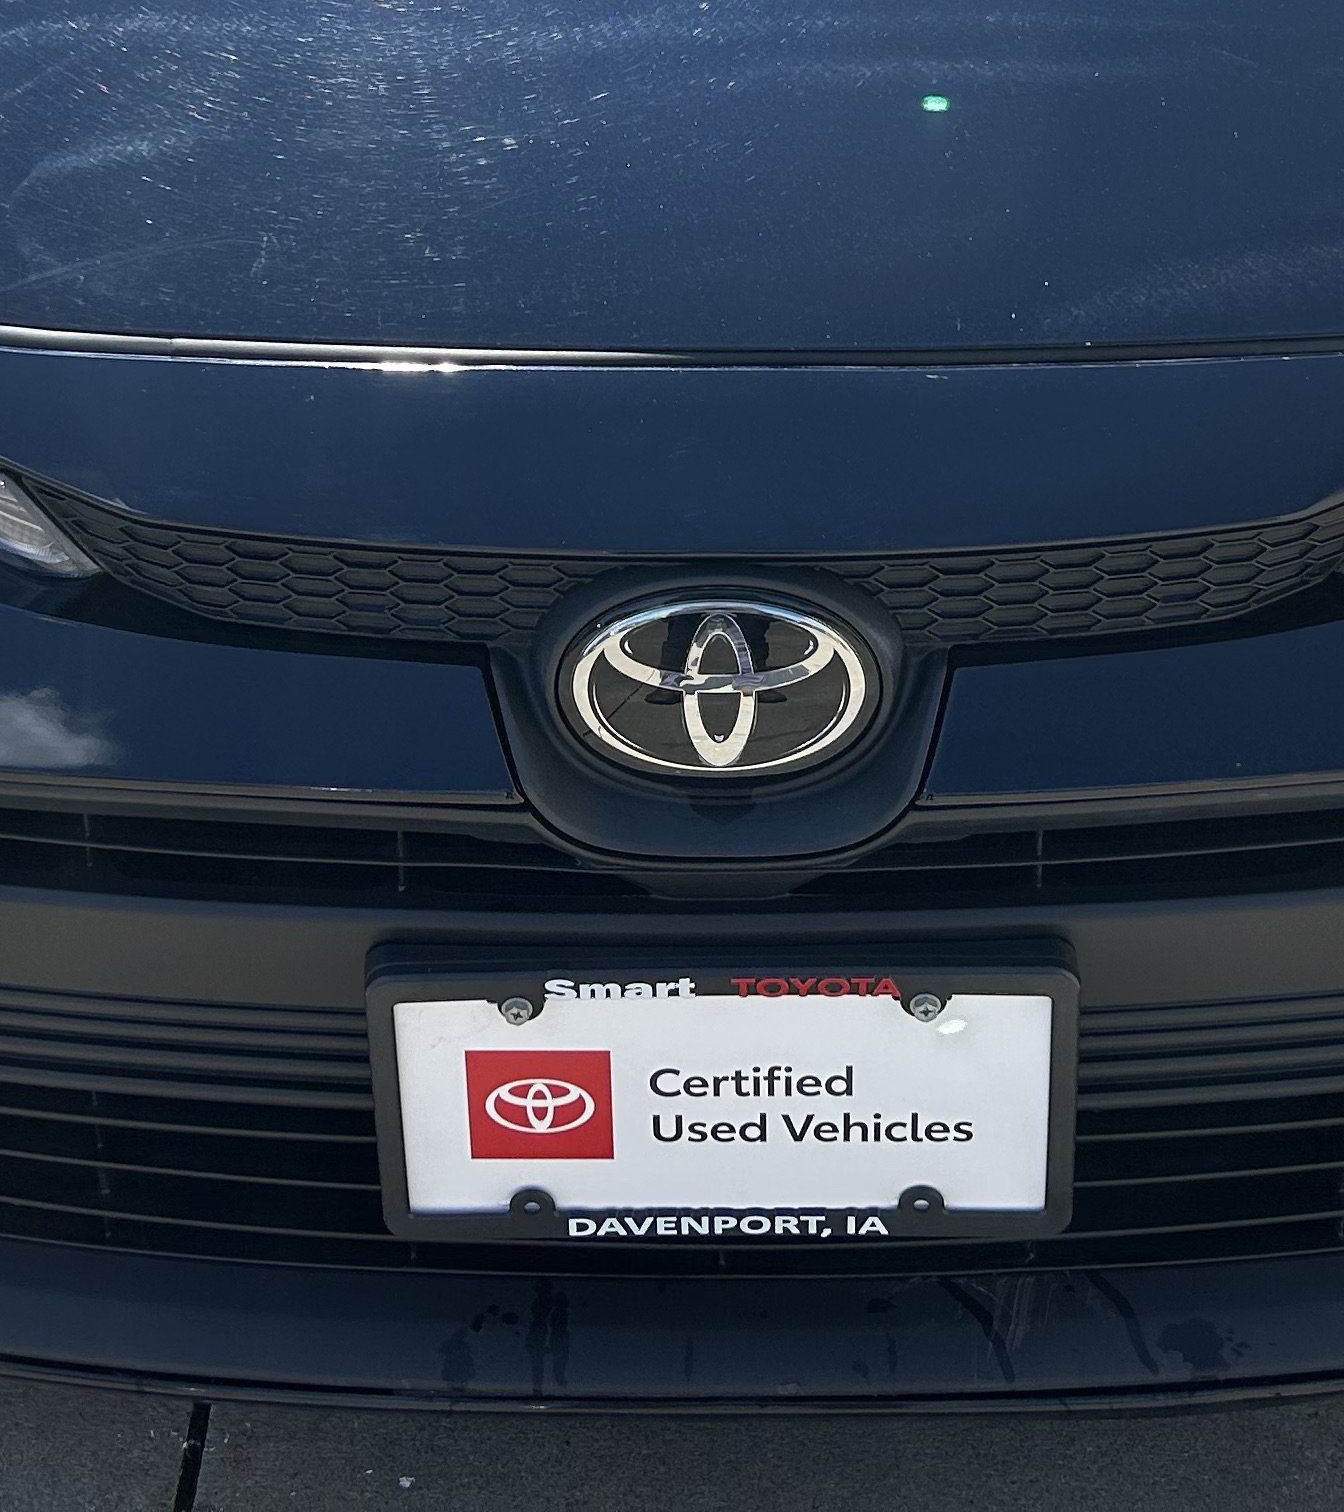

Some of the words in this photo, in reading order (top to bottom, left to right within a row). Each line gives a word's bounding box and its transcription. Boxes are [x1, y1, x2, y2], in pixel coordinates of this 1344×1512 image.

[544, 977, 696, 999] Smart
[730, 976, 900, 997] TOYOTA
[649, 1065, 853, 1097] Certified
[652, 1113, 766, 1142] Used
[782, 1112, 973, 1142] Vehicles
[568, 1216, 832, 1238] DAVENPORT,
[847, 1216, 889, 1235] IA
